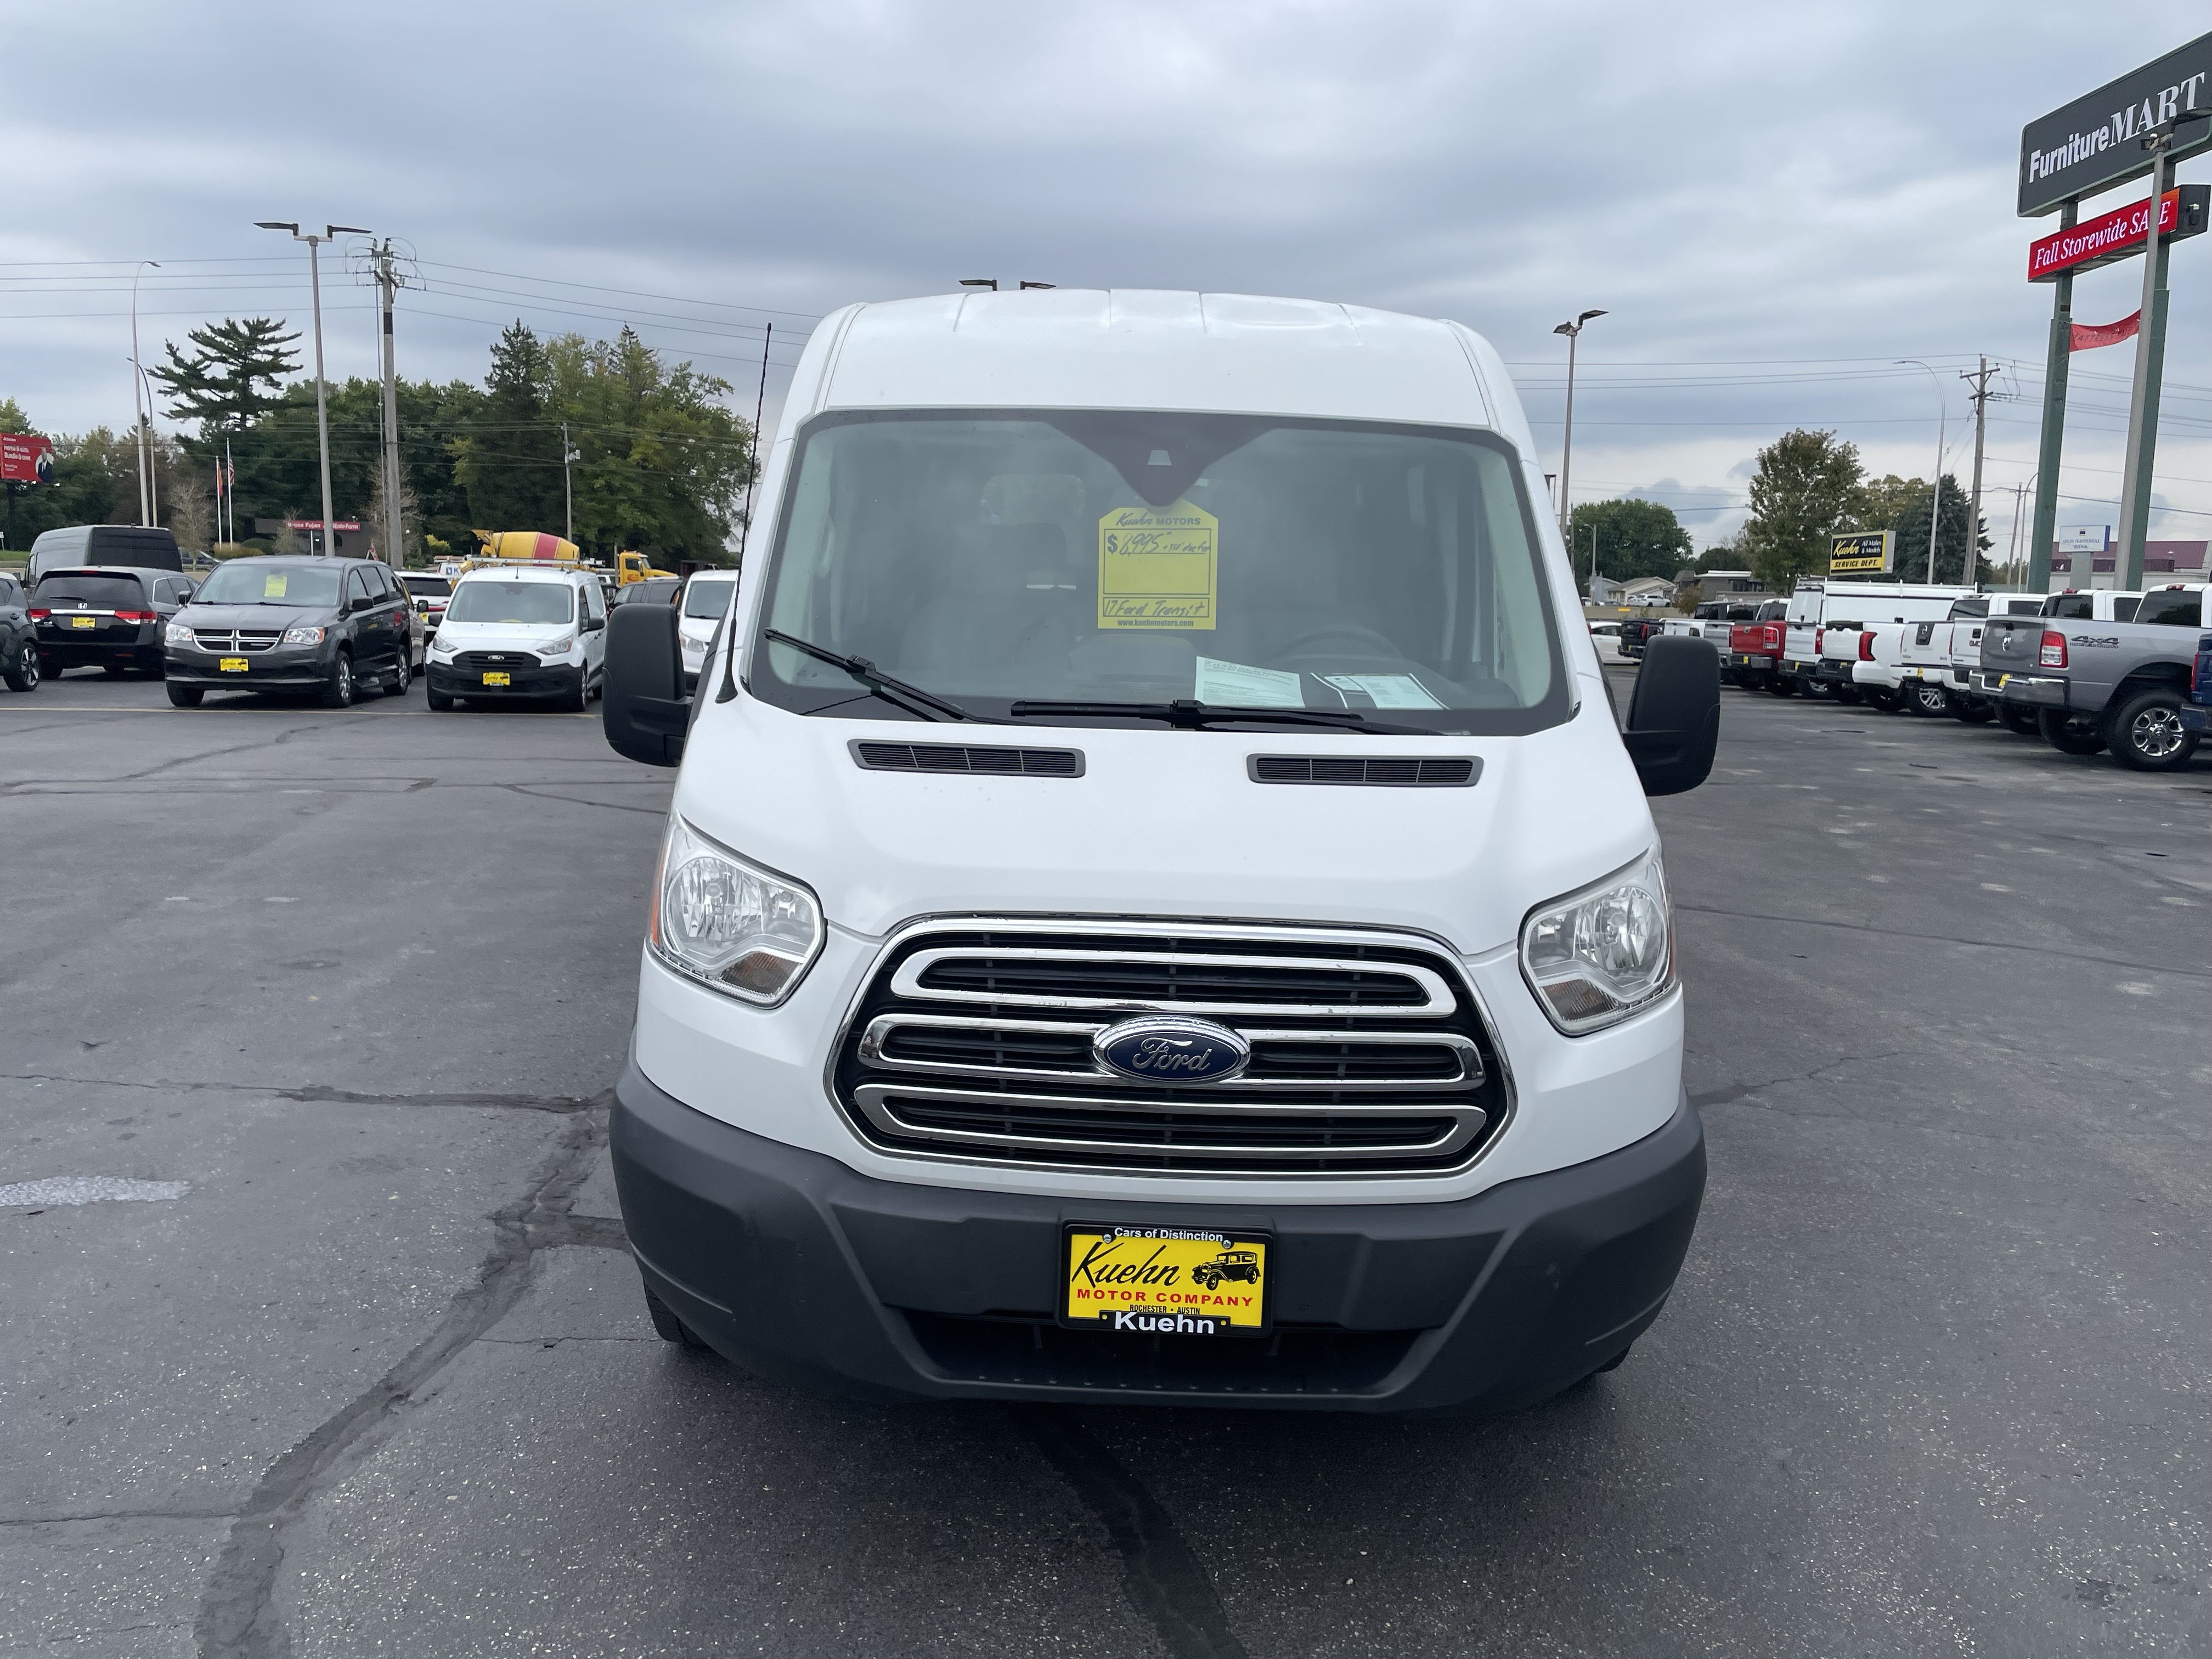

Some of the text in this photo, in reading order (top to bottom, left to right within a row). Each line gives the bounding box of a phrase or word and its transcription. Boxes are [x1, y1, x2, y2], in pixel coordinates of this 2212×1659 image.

[2034, 201, 2171, 269] Fall Storewide SAE
[1116, 512, 1201, 527] Kuehn MOTORS
[1833, 539, 1860, 557] Kuehn
[1834, 560, 1860, 568] SERVICE
[1115, 599, 1149, 616] Ford
[1152, 600, 1205, 616] Transit
[1132, 1037, 1212, 1071] Ford
[1114, 1227, 1223, 1242] Cars of Distinction
[1071, 1241, 1180, 1288] Kuehn
[1077, 1289, 1254, 1307] MOTOR COMPANY
[1130, 1304, 1200, 1315] ROCHESTER AUSTIN
[1115, 1311, 1214, 1334] Kuehn
